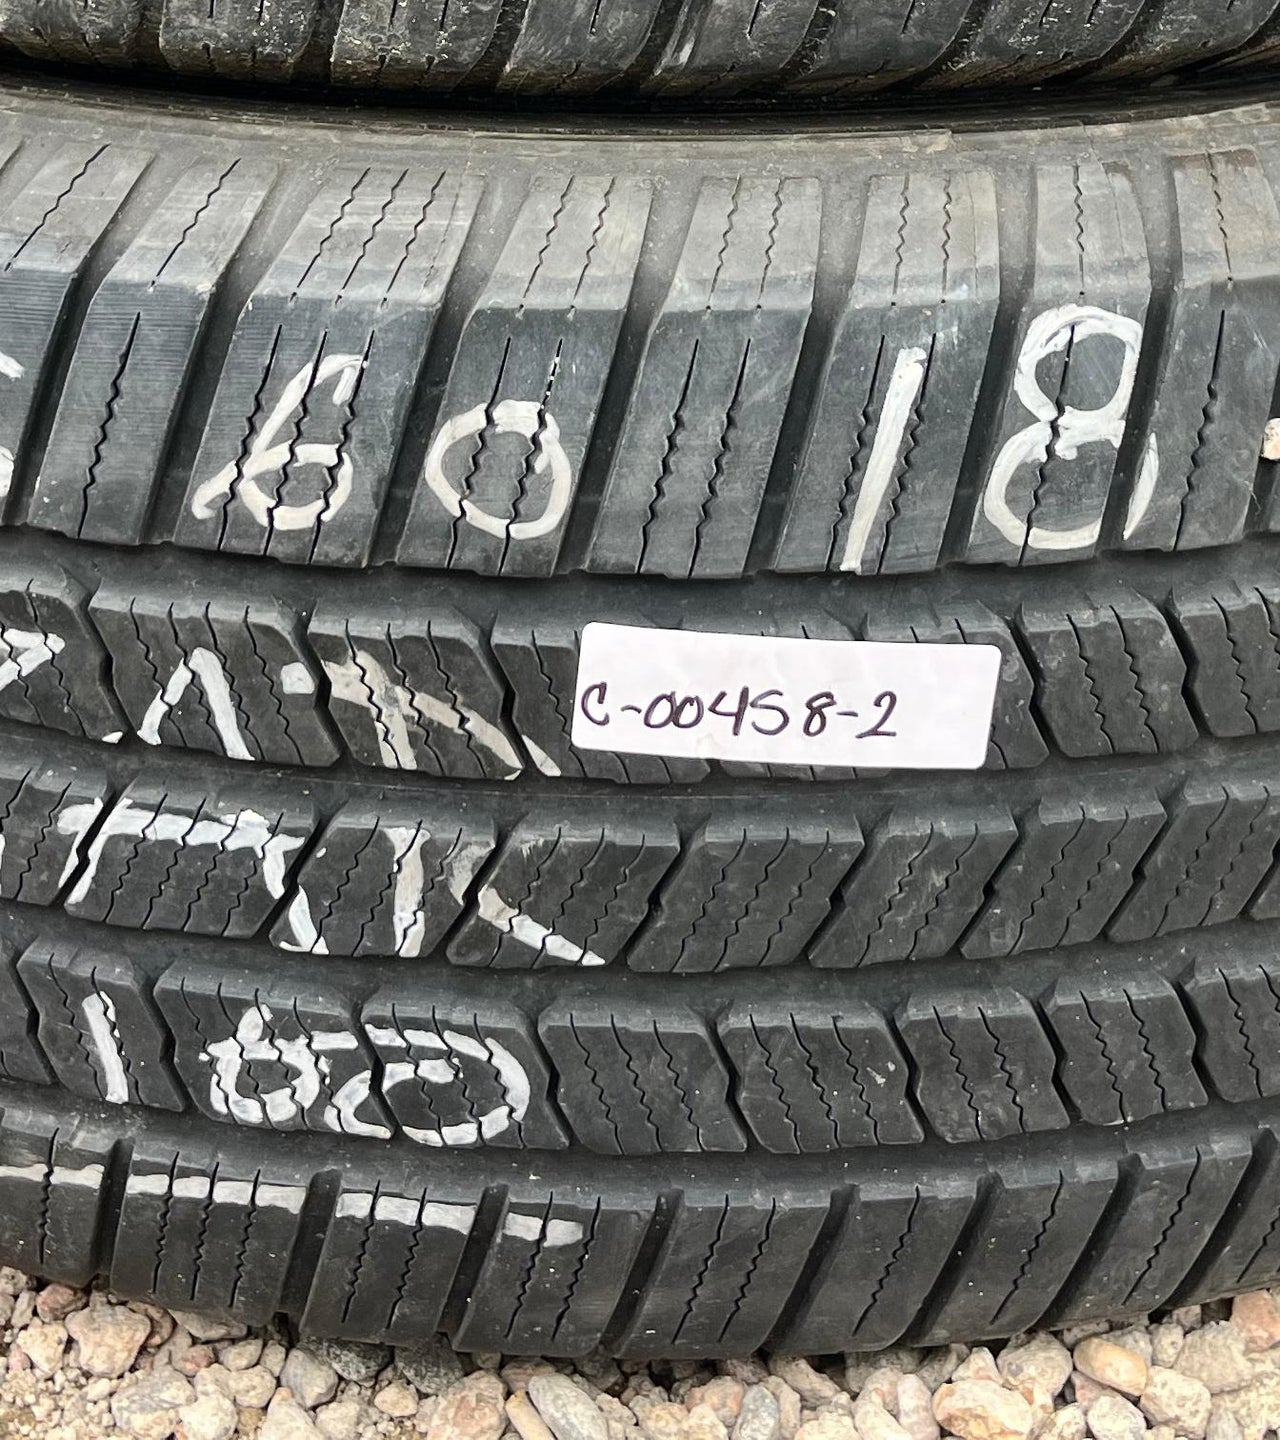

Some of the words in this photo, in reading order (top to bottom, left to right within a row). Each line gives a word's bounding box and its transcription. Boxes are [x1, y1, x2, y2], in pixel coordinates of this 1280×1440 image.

[192, 353, 573, 539] 60
[840, 303, 1158, 572] 18
[580, 681, 899, 738] C-00458-2
